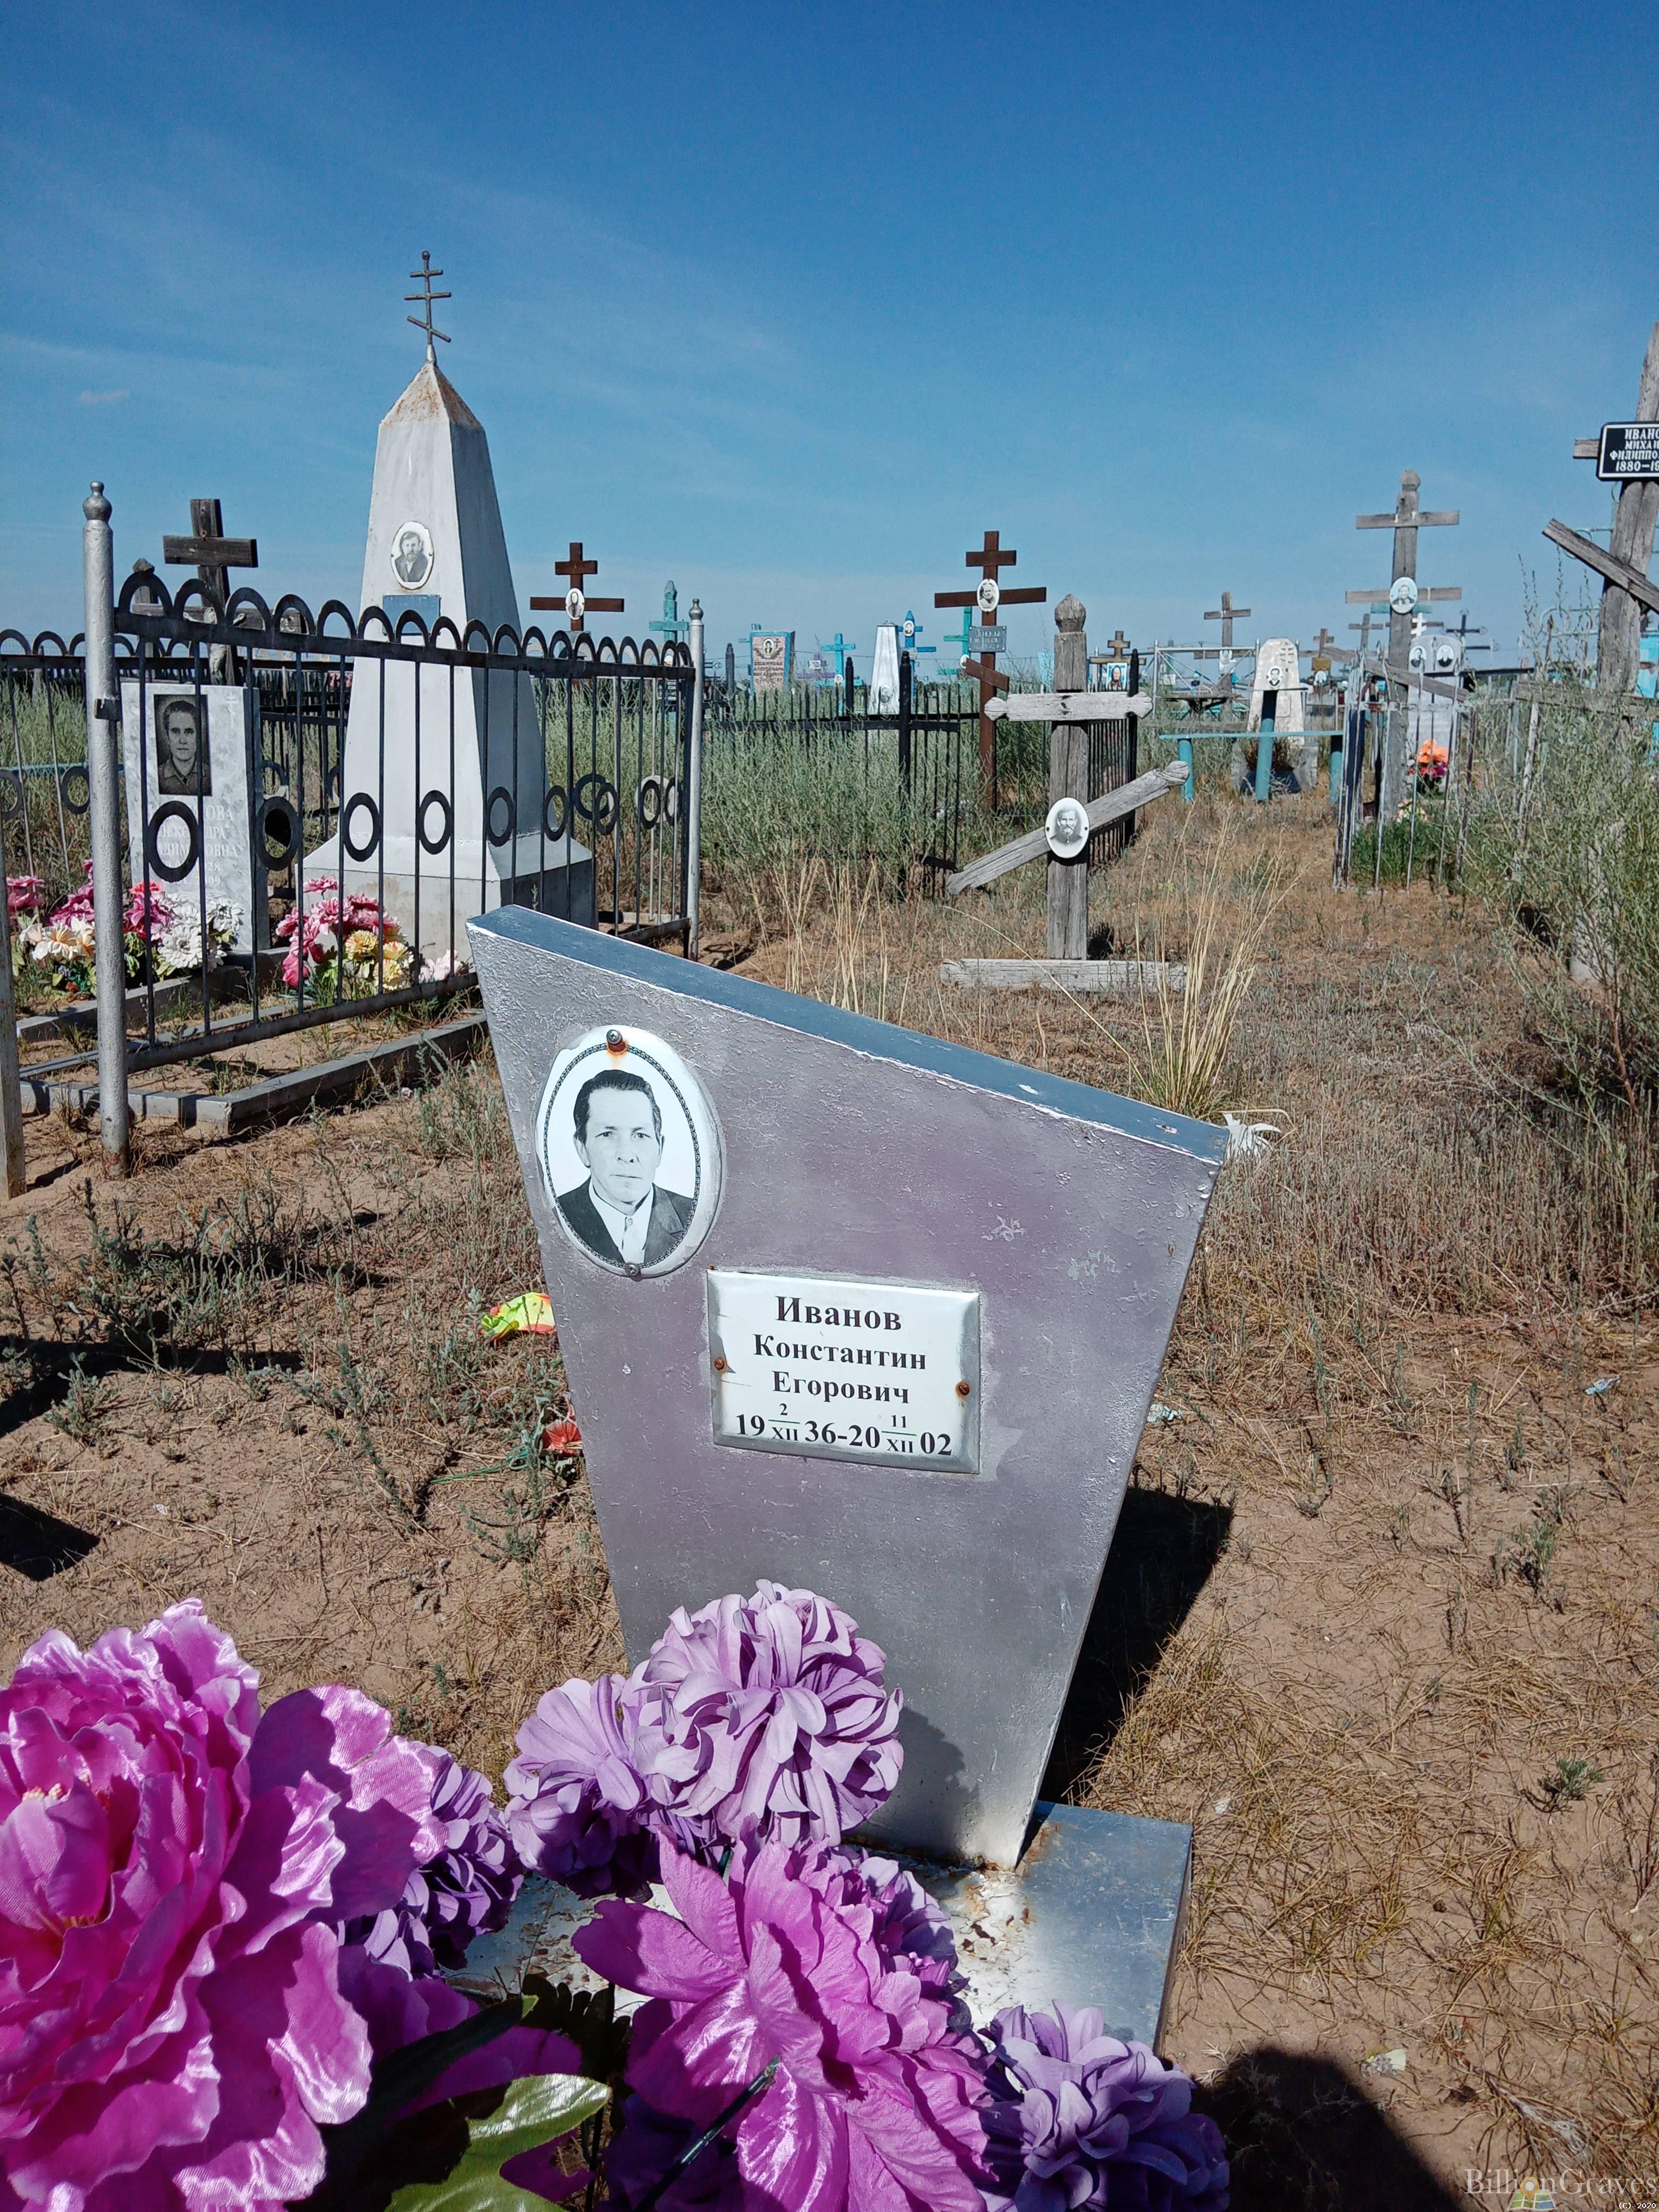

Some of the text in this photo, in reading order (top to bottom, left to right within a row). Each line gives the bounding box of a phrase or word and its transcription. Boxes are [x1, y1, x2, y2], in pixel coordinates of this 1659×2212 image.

[1610, 450, 1659, 460] ФИЛИППО
[775, 1295, 902, 1330] Иванов
[753, 1334, 926, 1370] Константин
[772, 1370, 909, 1404] Егорович
